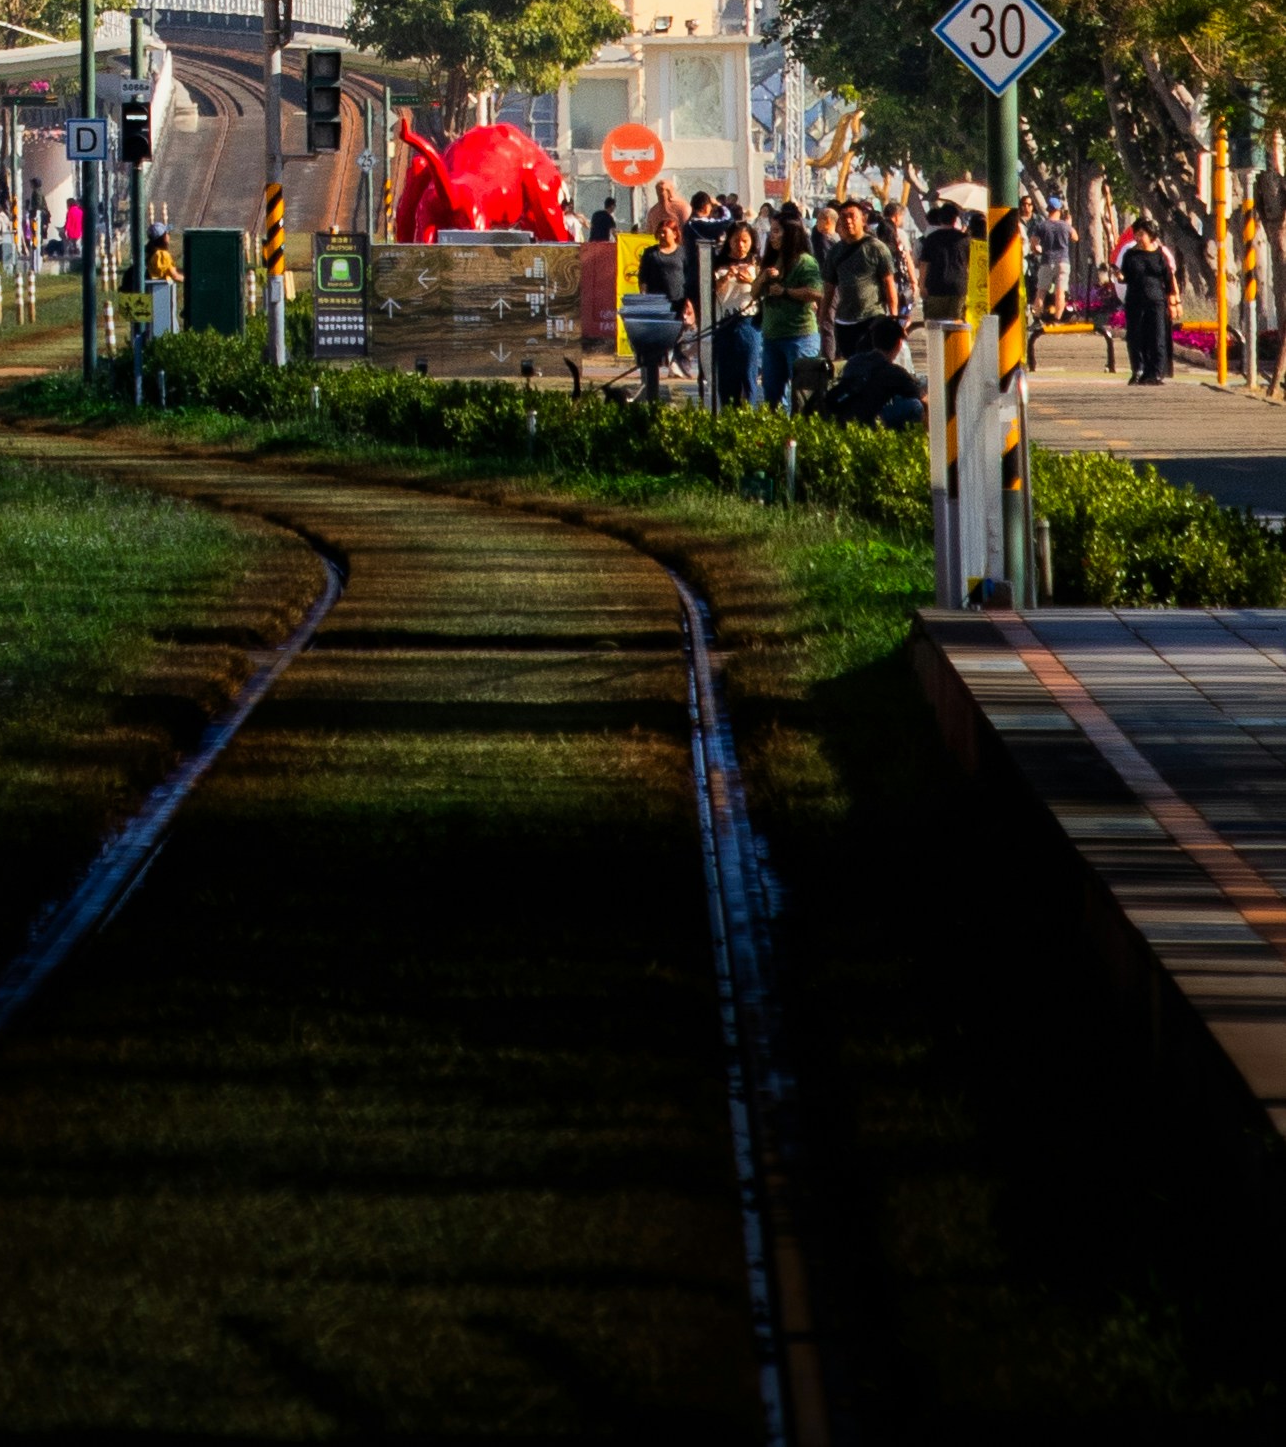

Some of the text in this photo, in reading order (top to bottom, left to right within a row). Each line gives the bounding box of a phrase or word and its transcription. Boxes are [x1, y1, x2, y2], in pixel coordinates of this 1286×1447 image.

[970, 3, 1026, 58] 30
[76, 127, 97, 152] D
[362, 154, 373, 167] 25
